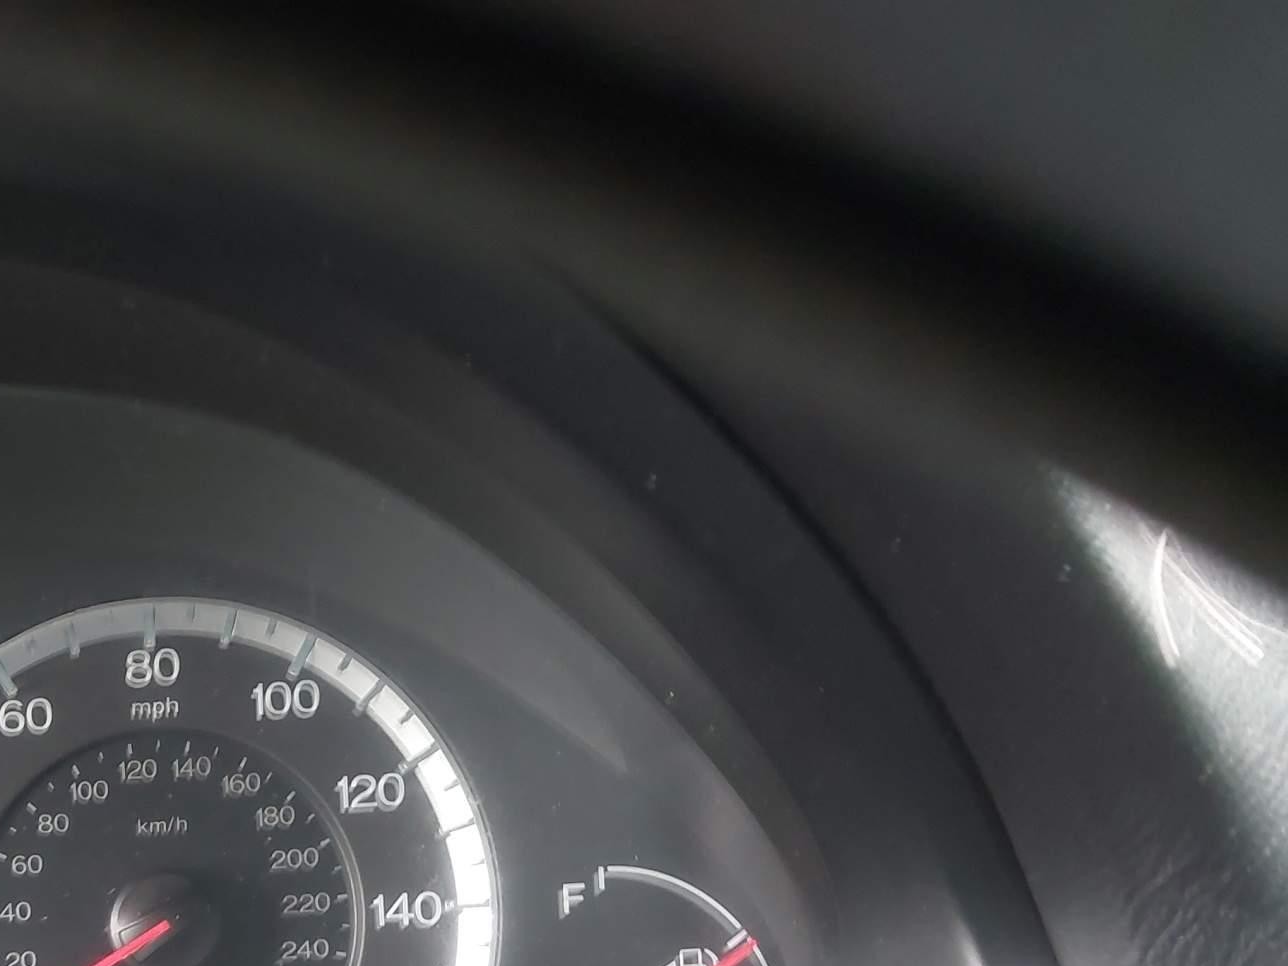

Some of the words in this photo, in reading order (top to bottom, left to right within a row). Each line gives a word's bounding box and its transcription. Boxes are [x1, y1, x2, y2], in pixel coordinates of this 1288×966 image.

[125, 648, 180, 687] 80
[131, 697, 179, 721] mph
[251, 679, 319, 719] 100
[119, 759, 156, 782] 120
[172, 755, 210, 781] 140
[70, 780, 108, 803] 100
[222, 771, 260, 795] 160
[335, 774, 404, 812] 120
[38, 811, 69, 833] 80
[136, 815, 188, 834] km/h
[256, 805, 295, 829] 180
[12, 854, 43, 875] 60
[271, 848, 319, 871] 200
[0, 901, 32, 922] 40
[282, 893, 330, 914] 220
[372, 892, 441, 928] 140
[559, 882, 586, 918] F
[280, 939, 329, 960] 240
